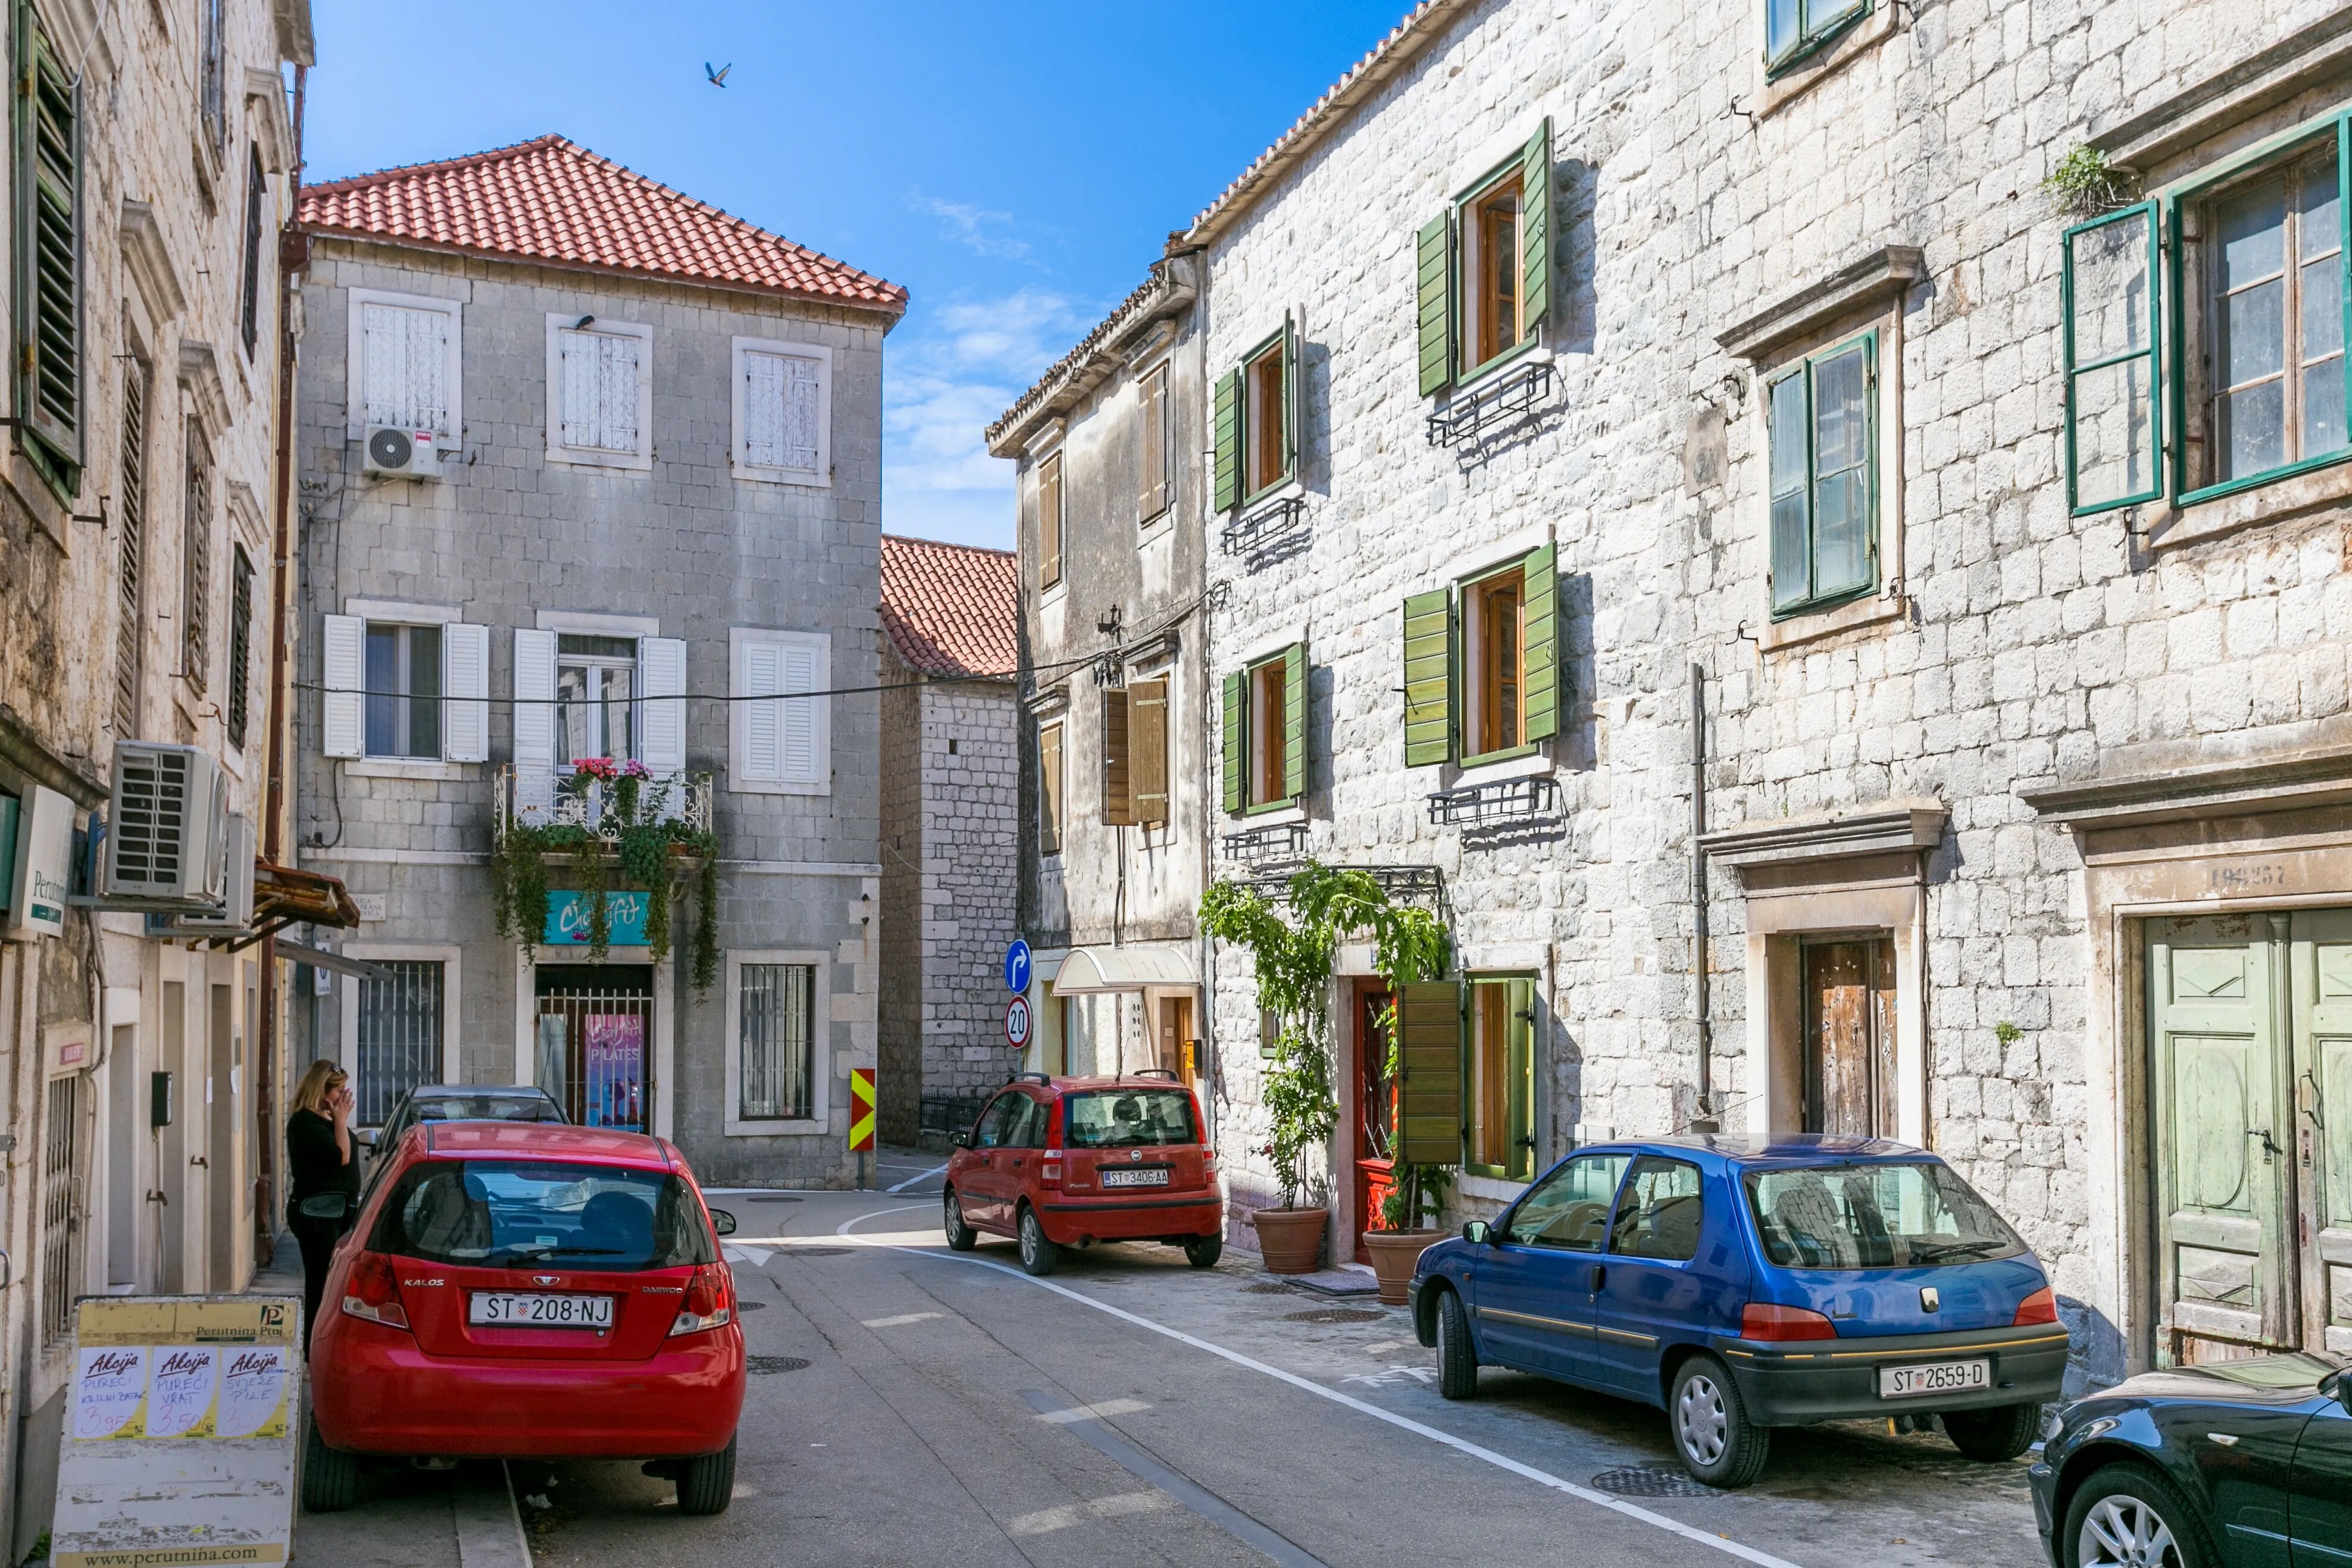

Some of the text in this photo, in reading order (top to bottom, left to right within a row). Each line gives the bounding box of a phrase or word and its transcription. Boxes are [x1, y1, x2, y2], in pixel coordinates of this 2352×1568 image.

[1010, 1009, 1025, 1035] 20
[591, 1048, 640, 1061] PLATES
[1111, 1172, 1124, 1184] ST
[404, 1278, 445, 1287] KALOS
[486, 1297, 609, 1322] ST 208-NJ
[196, 1326, 283, 1337] Perutnina Ptuj
[87, 1352, 139, 1376] Akcija
[160, 1351, 211, 1375] Akcija
[229, 1352, 279, 1375] Akcija
[1893, 1363, 1982, 1391] ST 2659-D
[161, 1392, 200, 1405] VRAT
[230, 1389, 273, 1404] PILE
[85, 1547, 258, 1568] www.perutnina.com
